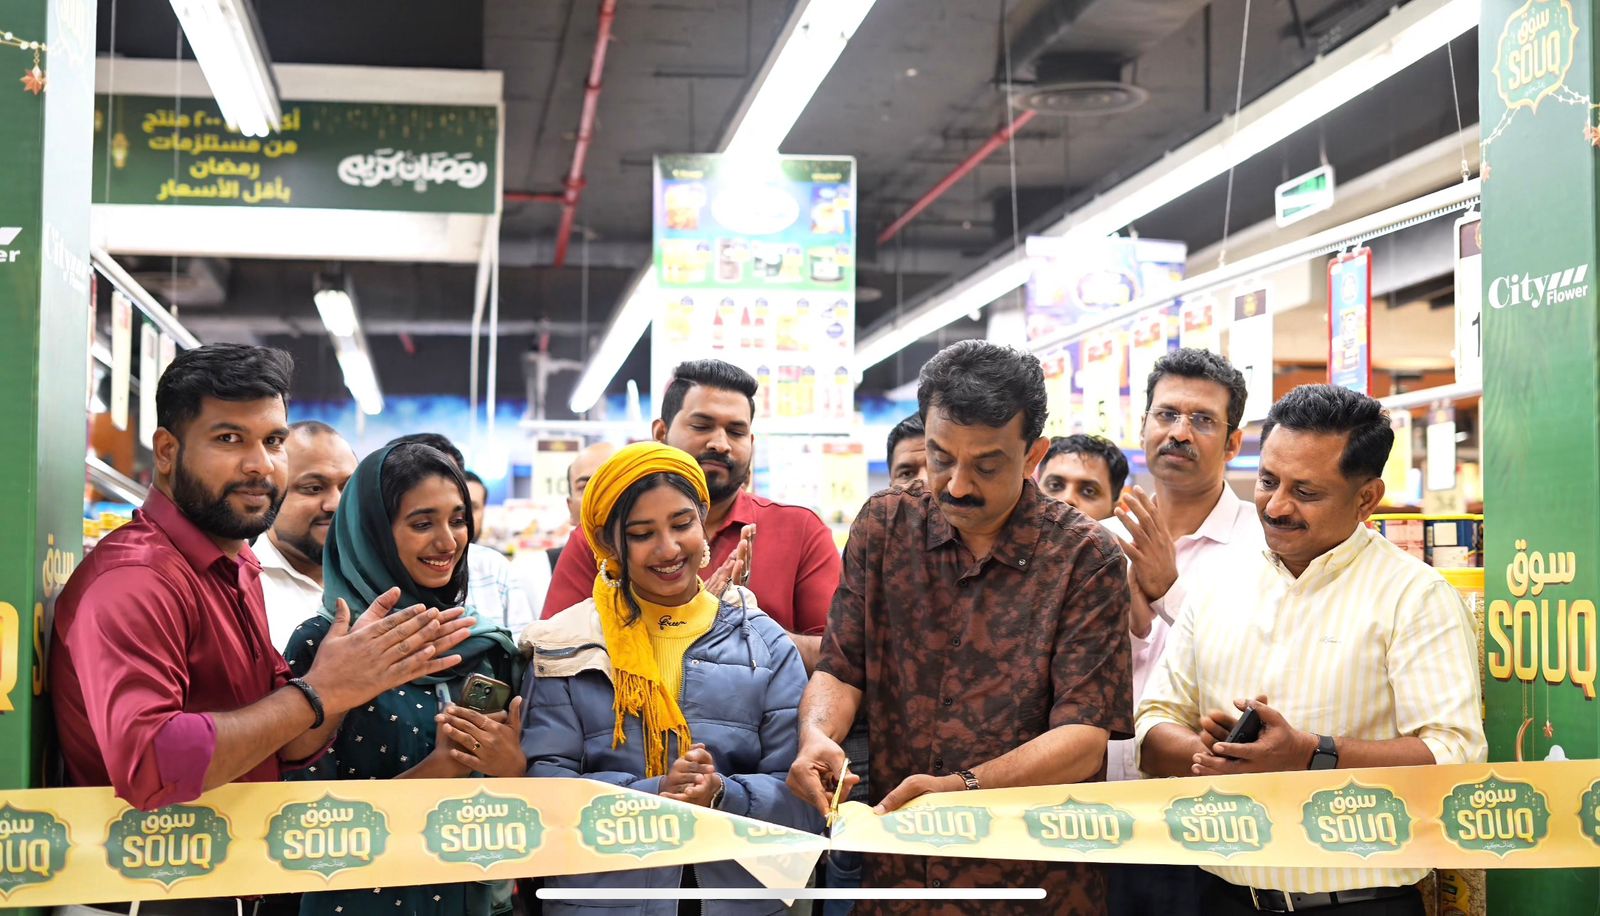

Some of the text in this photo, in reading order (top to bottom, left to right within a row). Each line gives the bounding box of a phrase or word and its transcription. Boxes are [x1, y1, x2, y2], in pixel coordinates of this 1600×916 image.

[1518, 8, 1550, 45] سوق
[1508, 30, 1560, 90] SOUQ
[148, 133, 298, 158] من مستلزمات
[189, 156, 261, 180] رمضان
[156, 176, 291, 203] بأقل الأسعار
[1488, 271, 1550, 309] City
[1546, 285, 1588, 306] Flower
[1506, 539, 1576, 597] سوق
[1488, 599, 1598, 698] SOUQ
[457, 799, 509, 823] سوق
[610, 794, 661, 817] سوق
[1190, 797, 1238, 816] سوق
[1330, 790, 1376, 815] سوق
[1469, 783, 1517, 809] سوق
[300, 802, 354, 828] سوق
[595, 814, 680, 845] SOUQ
[895, 811, 977, 841] SOUQ
[1040, 812, 1120, 844] SOUQ
[1318, 812, 1398, 846] SOUQ
[1457, 808, 1534, 843] SOUQ
[283, 827, 371, 860] SOUQ
[441, 822, 527, 853] SOUQ
[1181, 815, 1260, 847] SOUQ
[122, 833, 213, 869] SOUQ
